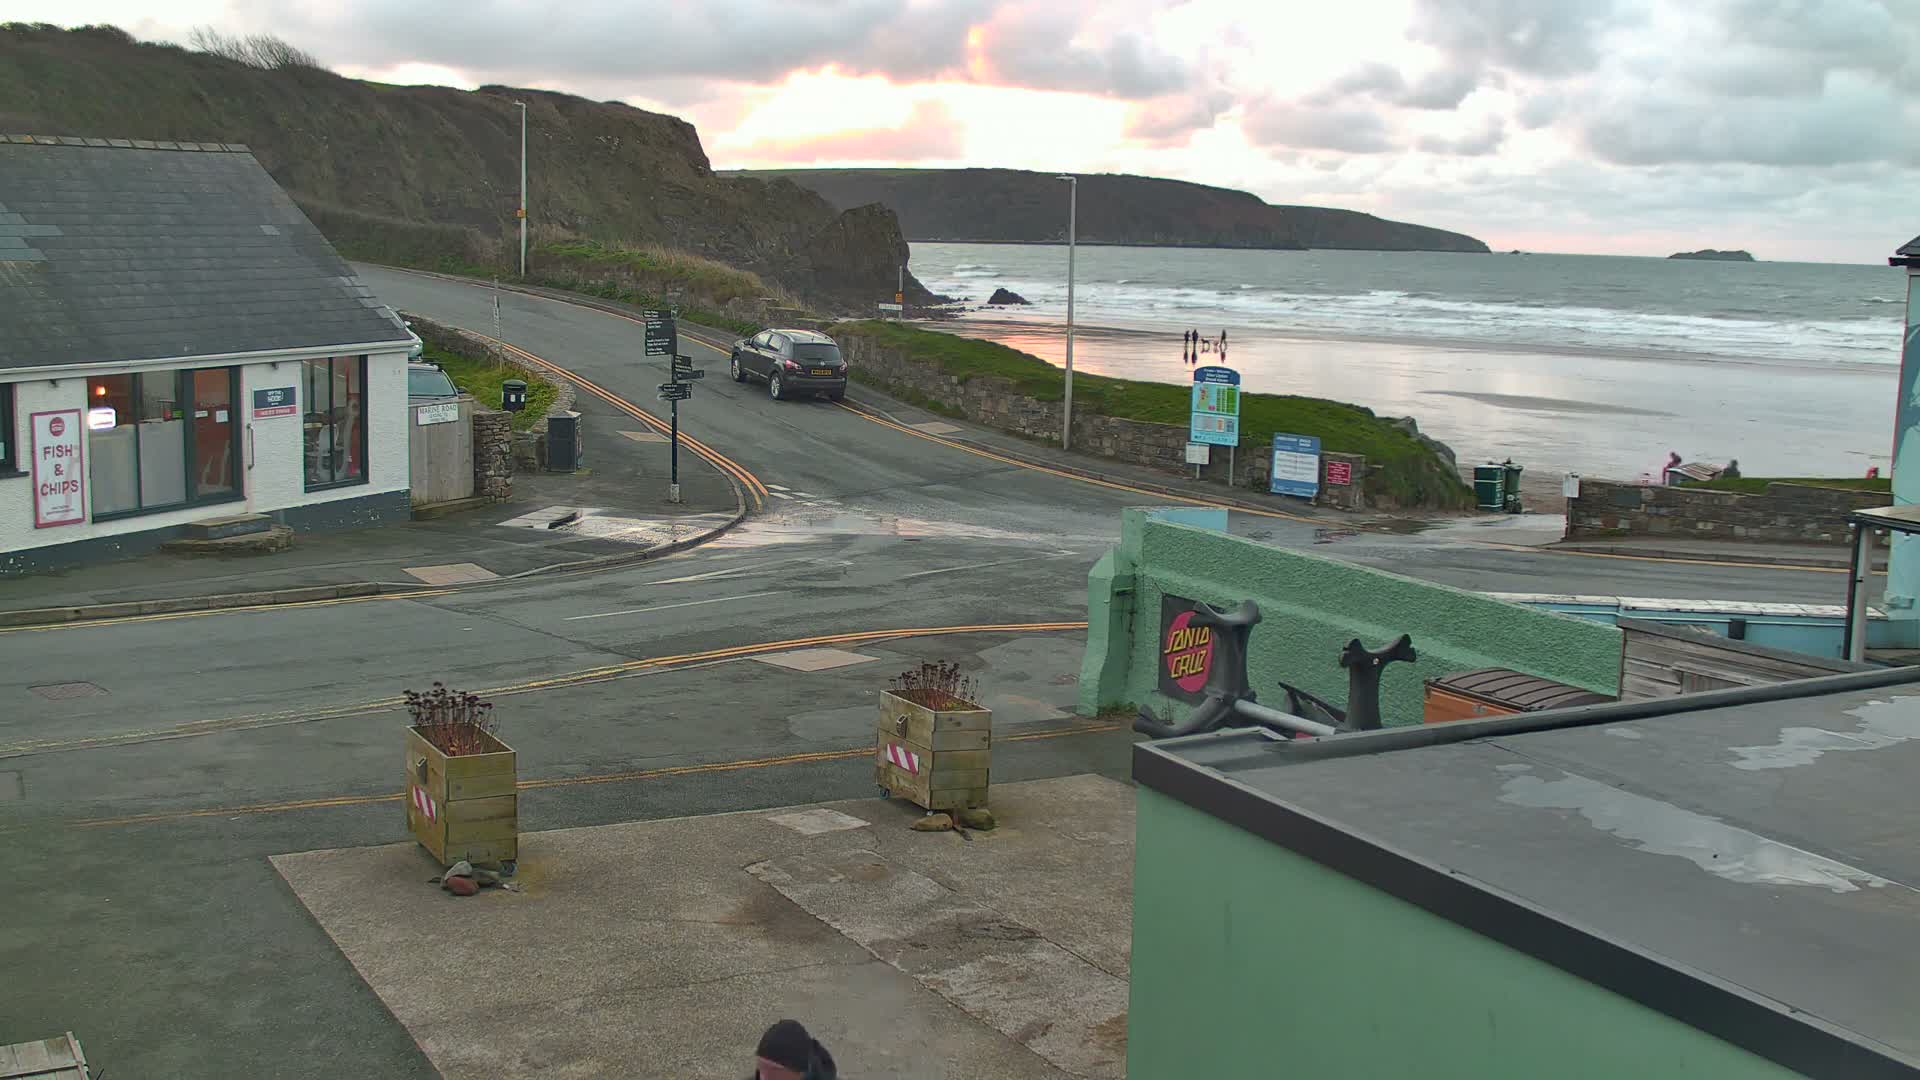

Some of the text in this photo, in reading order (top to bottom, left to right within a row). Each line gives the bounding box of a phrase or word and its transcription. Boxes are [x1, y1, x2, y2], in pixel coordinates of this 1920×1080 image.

[419, 404, 457, 414] MARINE ROAD
[43, 444, 73, 461] FISH
[54, 463, 64, 477] &
[40, 479, 78, 497] CHIPS
[1164, 626, 1210, 654] SANTA
[1170, 649, 1206, 678] CRUZ
